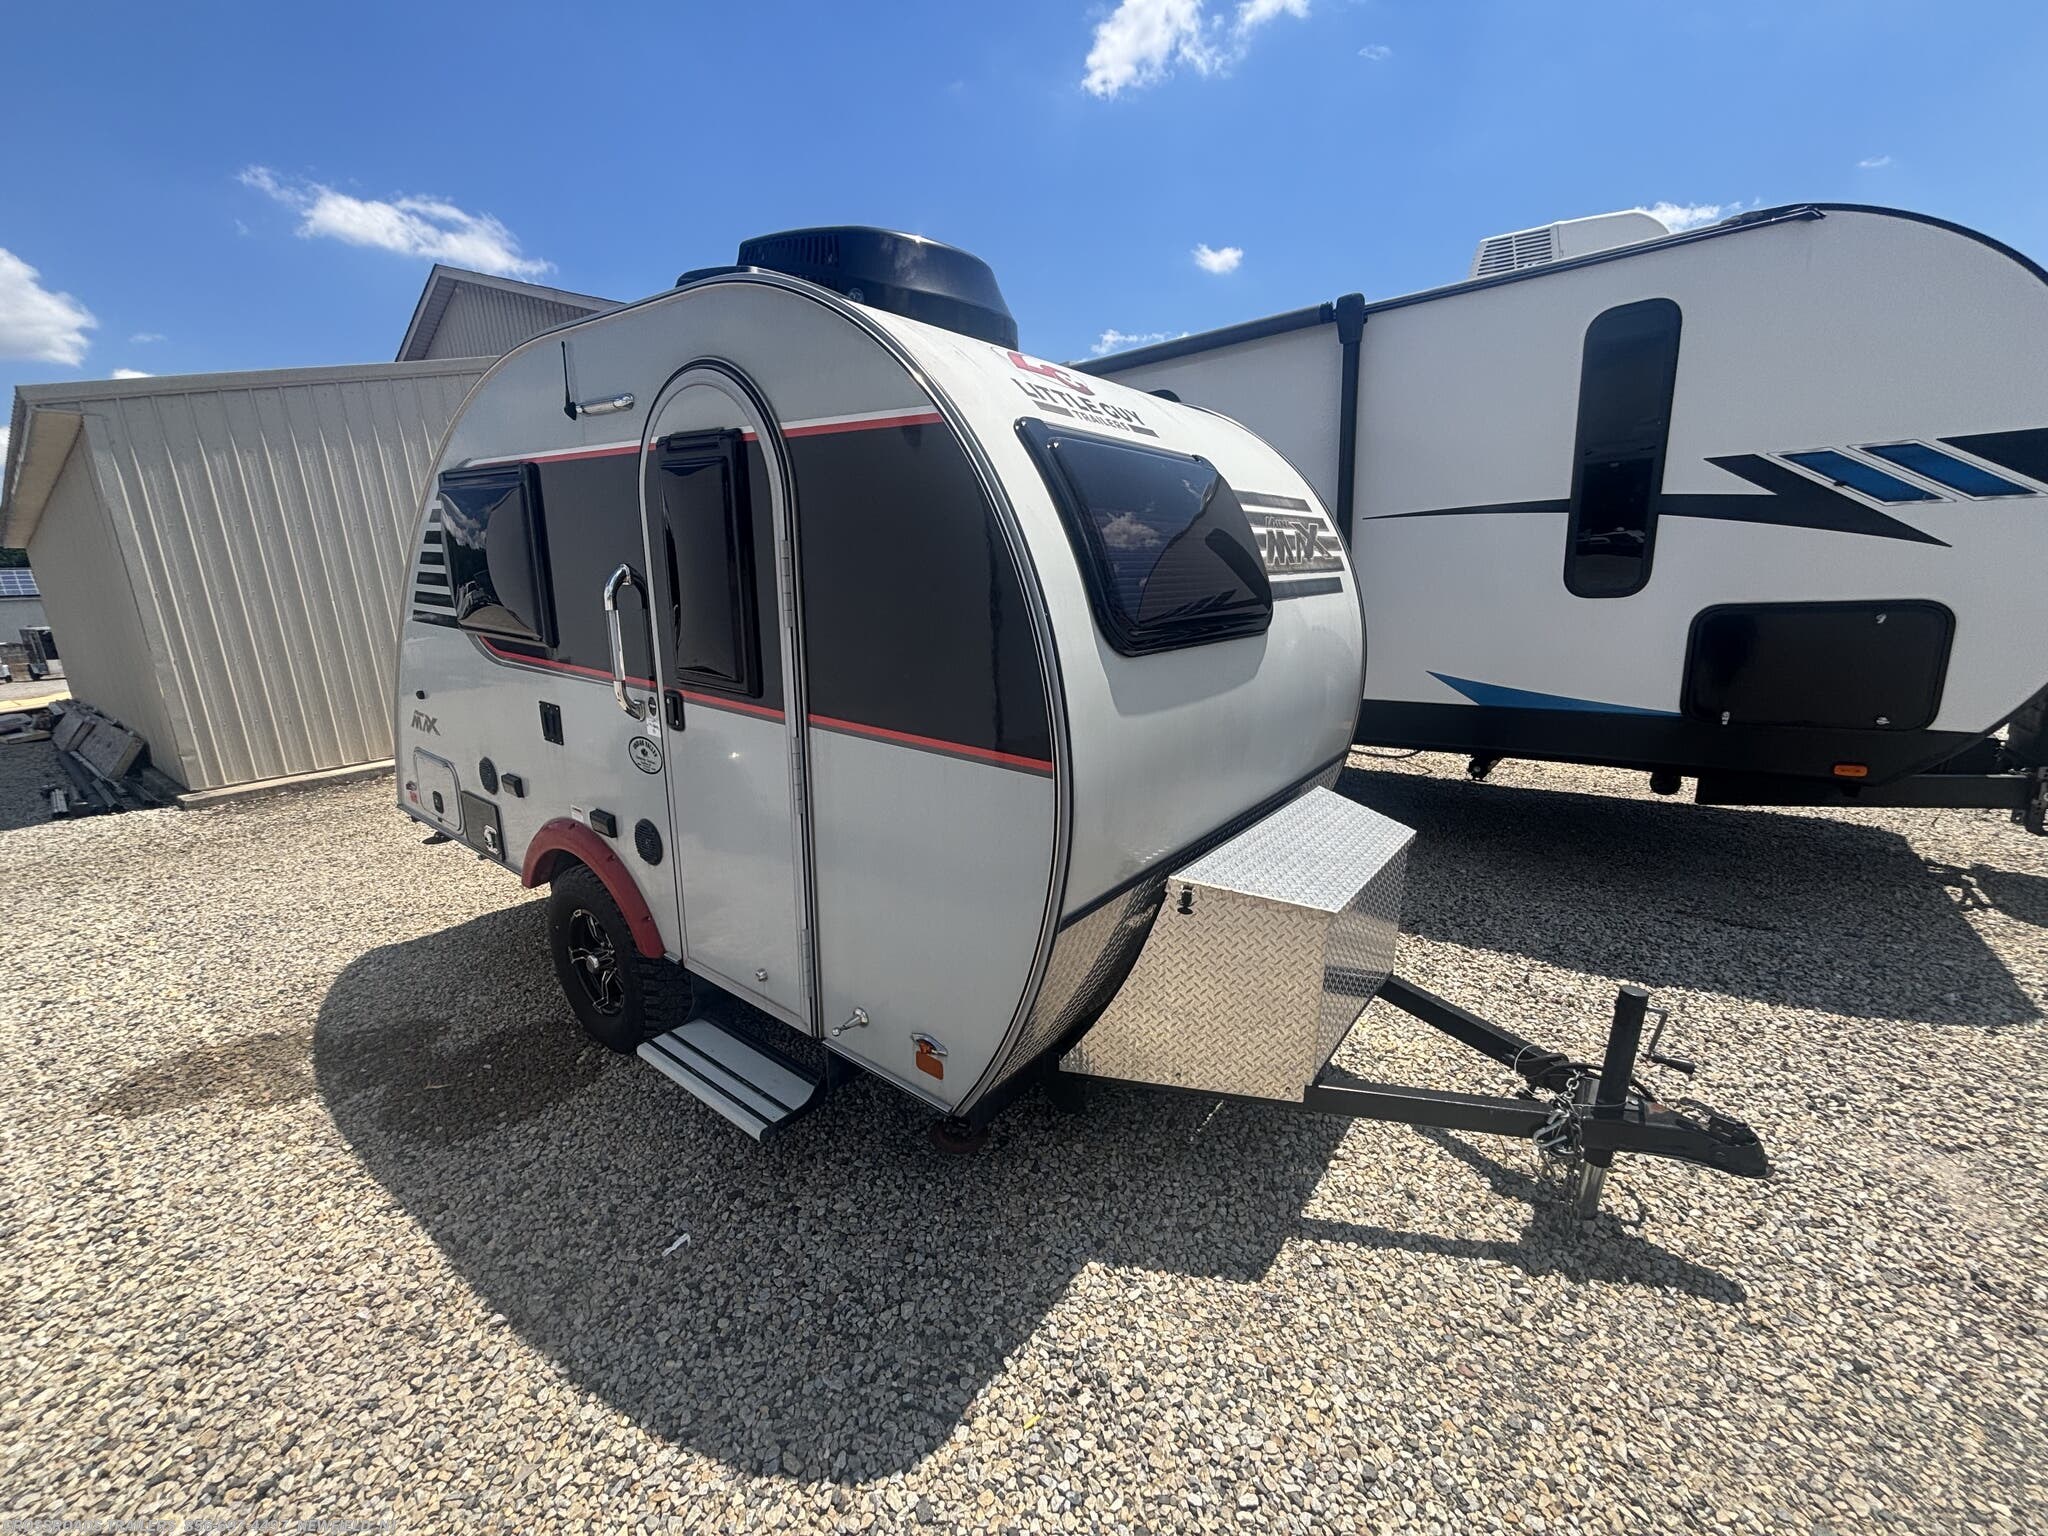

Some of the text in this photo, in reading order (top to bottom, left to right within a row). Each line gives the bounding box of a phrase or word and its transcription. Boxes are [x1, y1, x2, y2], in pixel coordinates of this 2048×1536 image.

[1010, 378, 1146, 426] LITTLE GUY
[1072, 410, 1130, 432] TRAILERS
